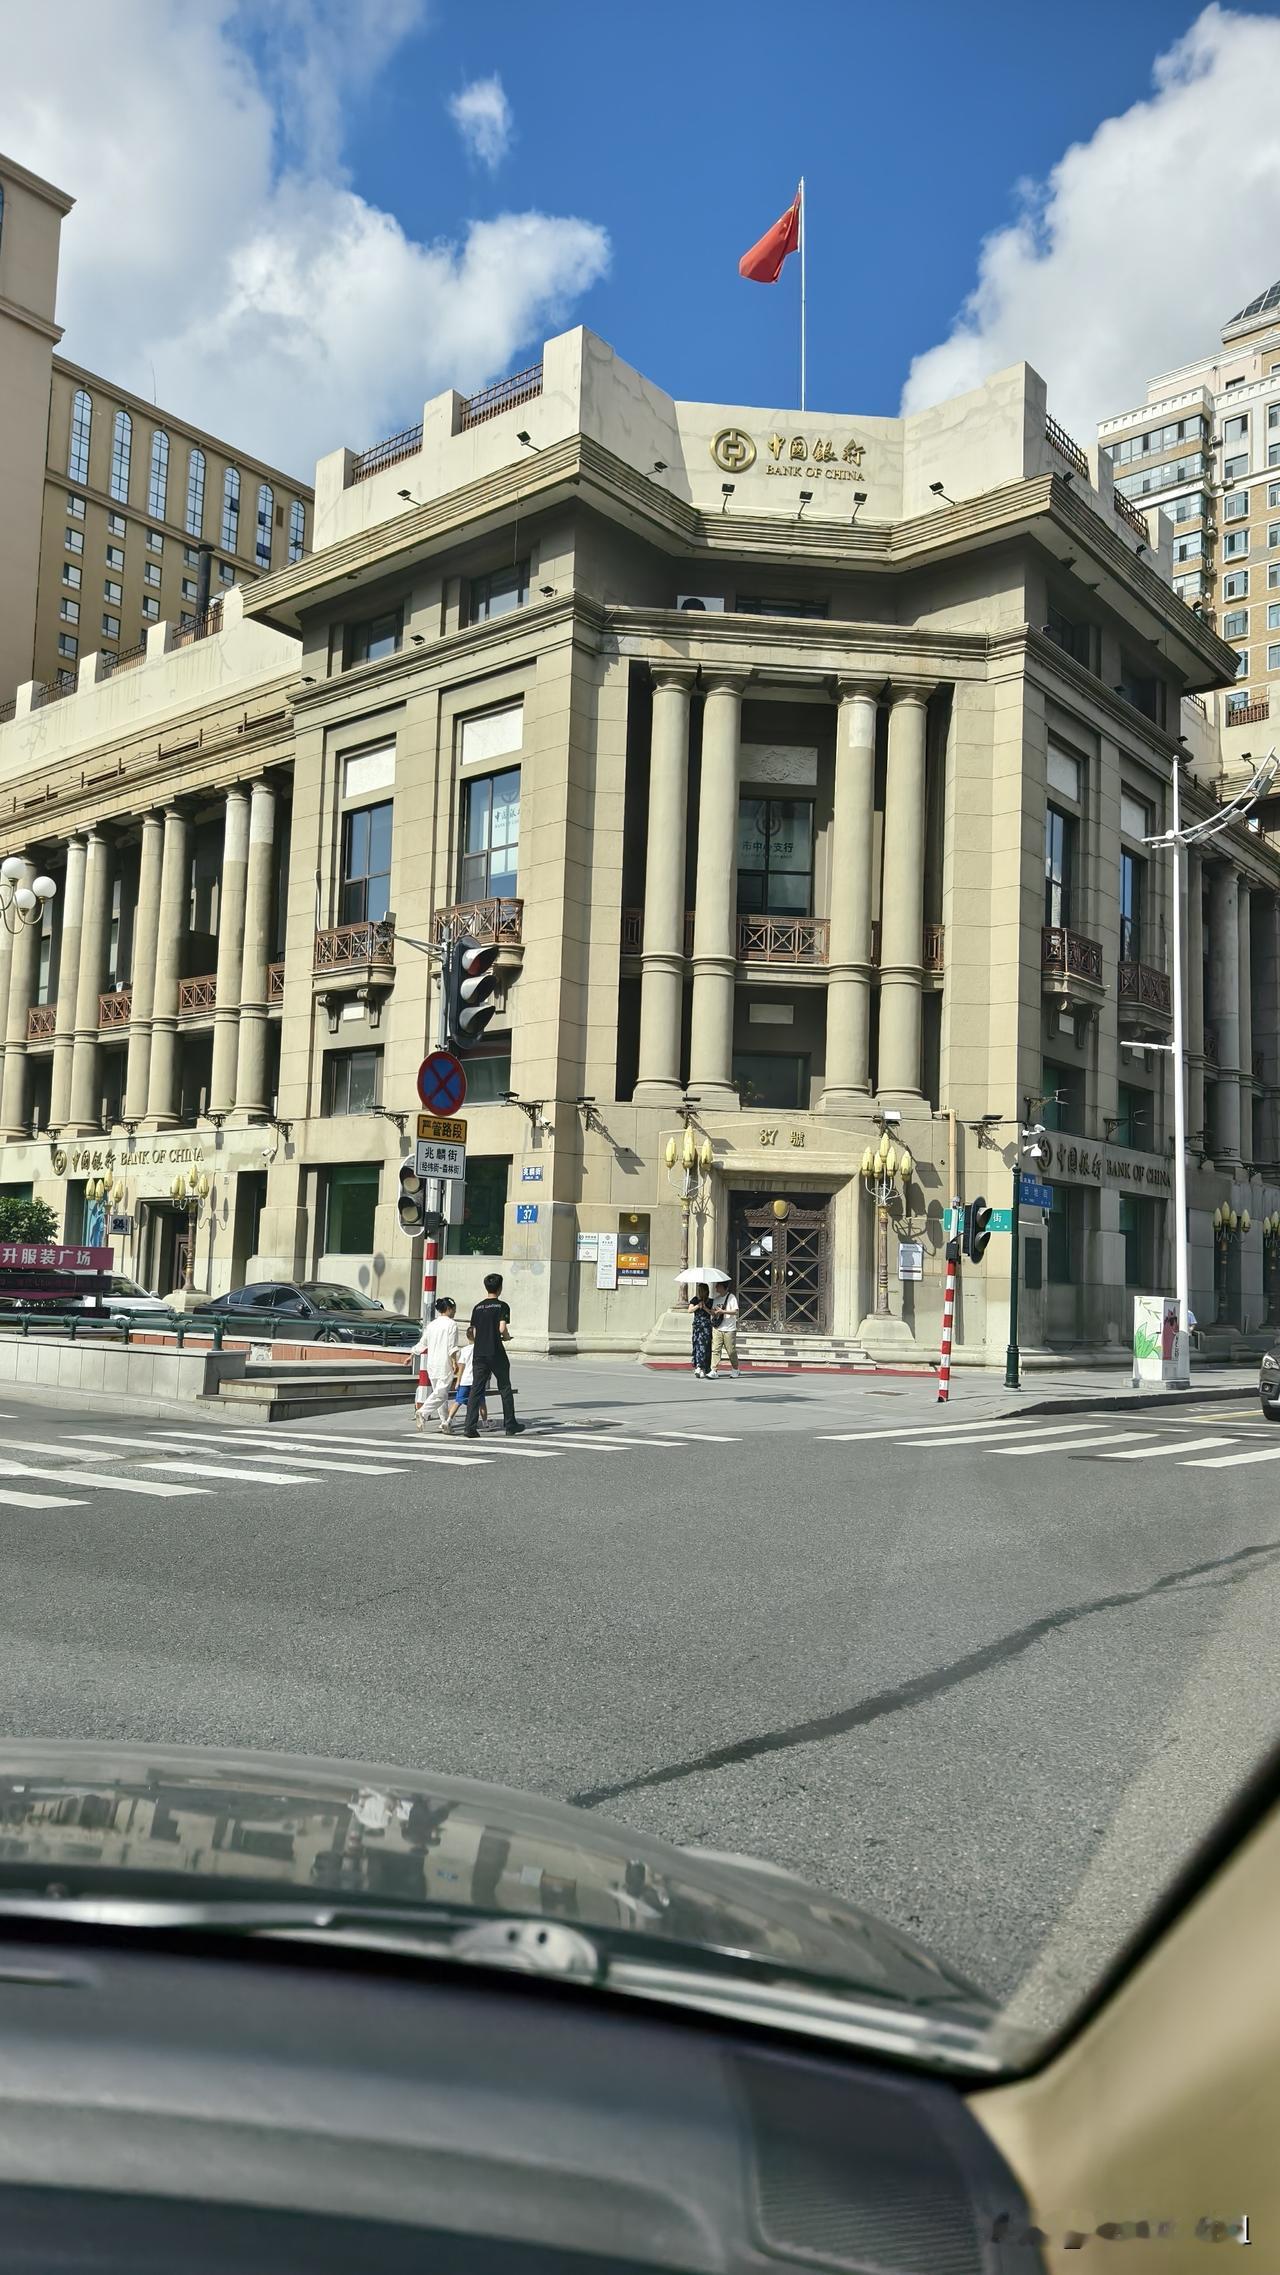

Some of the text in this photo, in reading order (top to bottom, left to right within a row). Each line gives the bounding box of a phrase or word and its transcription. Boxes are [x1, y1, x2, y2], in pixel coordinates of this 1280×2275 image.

[766, 465, 865, 481] BANK OF CHINA
[421, 1119, 463, 1139] 严管路段
[120, 1147, 204, 1165] BANK OF CHINA
[424, 1146, 458, 1161] 兆麟街
[1106, 1159, 1171, 1188] BANK OF CHINA
[523, 1209, 532, 1220] 37
[2, 1247, 91, 1266] 升服装广场
